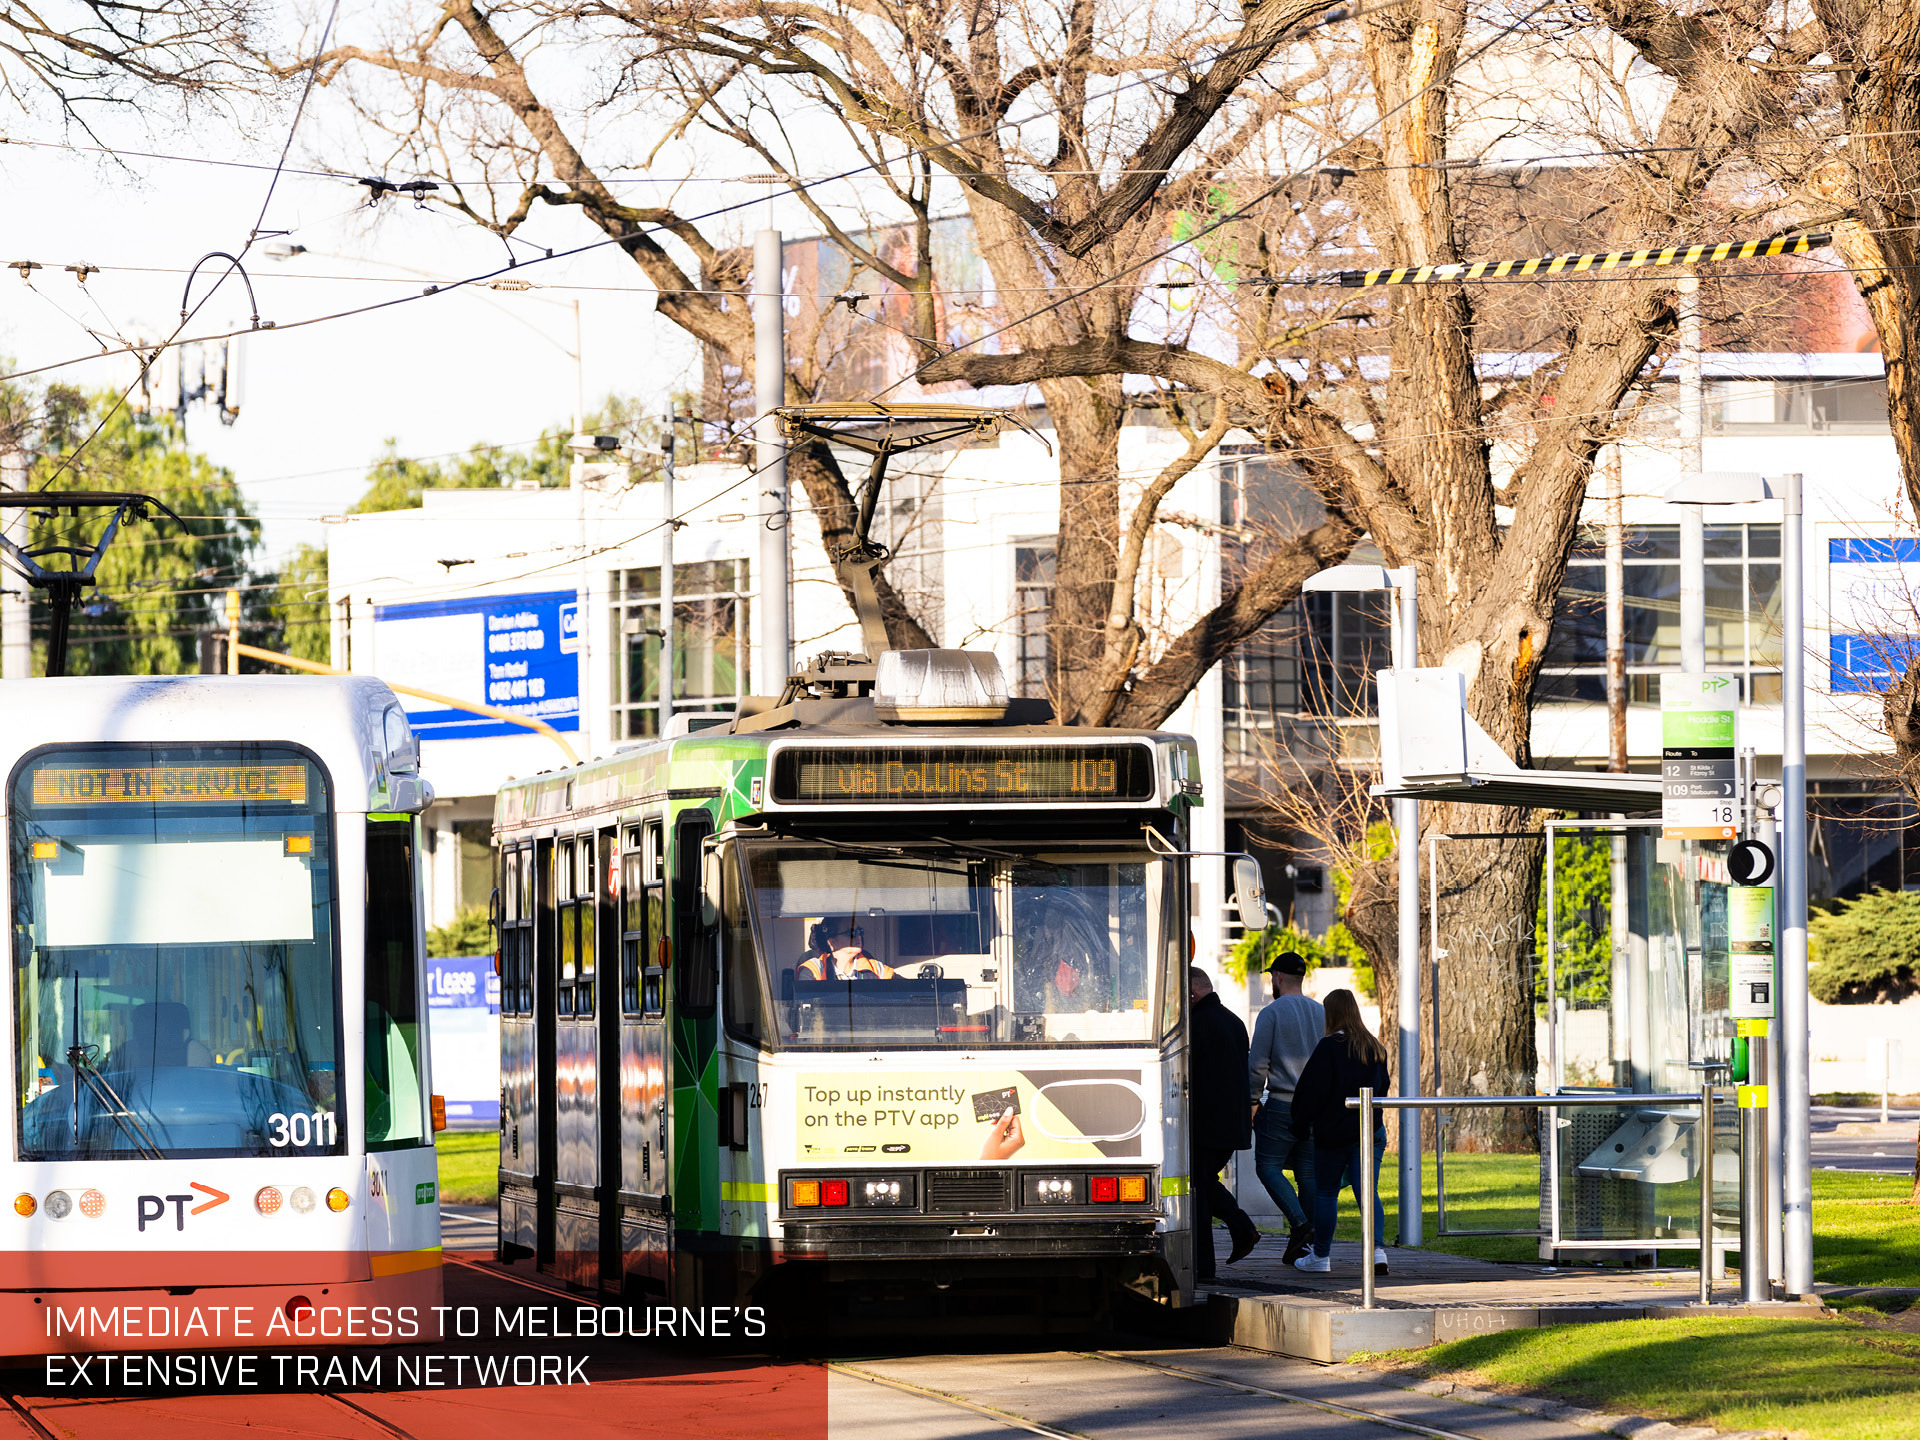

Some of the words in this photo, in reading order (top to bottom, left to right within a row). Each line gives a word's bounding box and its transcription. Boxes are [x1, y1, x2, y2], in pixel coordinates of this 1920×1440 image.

[1688, 715, 1719, 724] Hoddle
[1720, 715, 1731, 723] St
[838, 763, 877, 793] via
[885, 761, 987, 793] Collins
[995, 759, 1029, 793] St
[1070, 759, 1115, 793] 109
[1665, 765, 1680, 777] 12
[58, 772, 111, 797] NOT
[122, 771, 151, 796] IN
[162, 769, 278, 796] SERVICE
[1666, 784, 1688, 796] 109
[1712, 807, 1733, 822] 18
[436, 967, 476, 995] Lease
[750, 1082, 769, 1108] 267
[804, 1086, 841, 1106] Top
[847, 1089, 872, 1106] up
[877, 1085, 966, 1105] instantly
[268, 1112, 336, 1147] 3011
[804, 1114, 829, 1127] on
[835, 1111, 867, 1126] the
[874, 1110, 916, 1126] PTV
[920, 1112, 959, 1129] app
[371, 1170, 388, 1197] 3011
